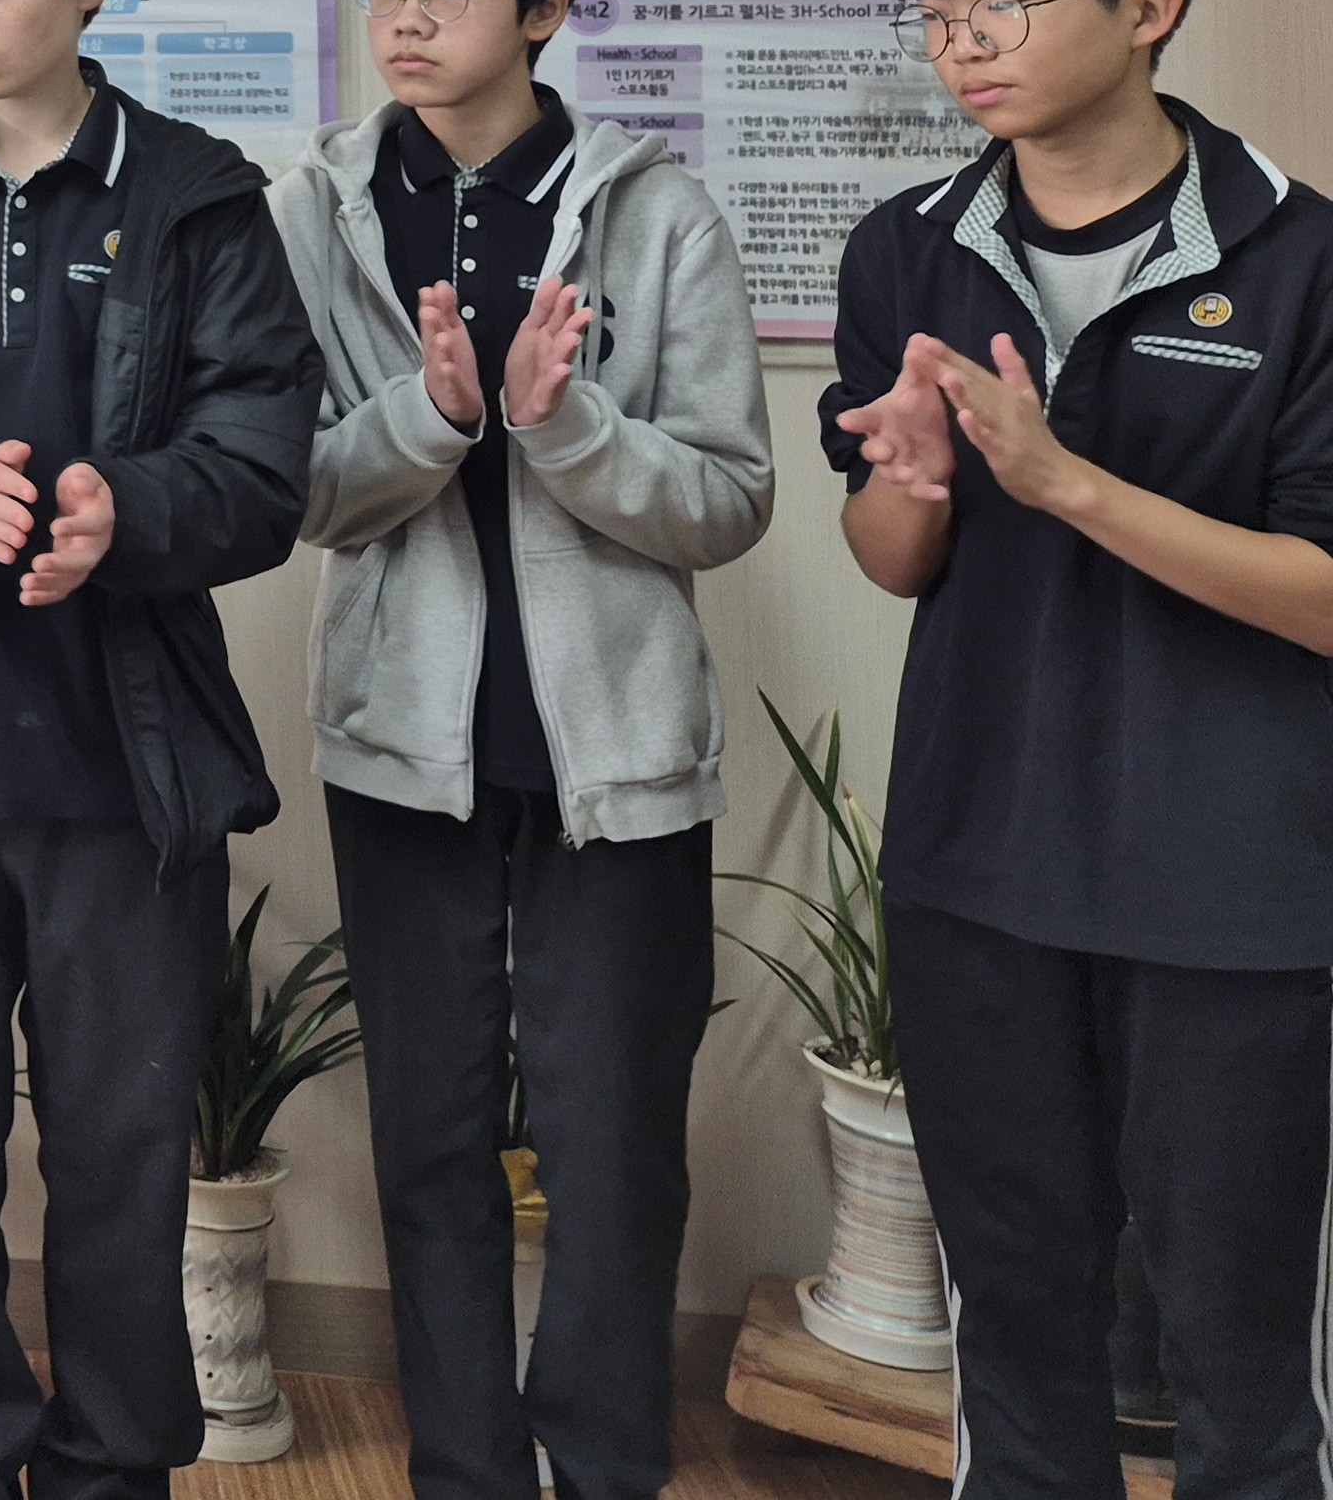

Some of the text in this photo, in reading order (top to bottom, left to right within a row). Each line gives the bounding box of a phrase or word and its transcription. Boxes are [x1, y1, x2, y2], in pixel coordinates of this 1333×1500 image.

[689, 3, 871, 19] 기르고 펼치는 3H-School
[597, 48, 677, 60] Health School
